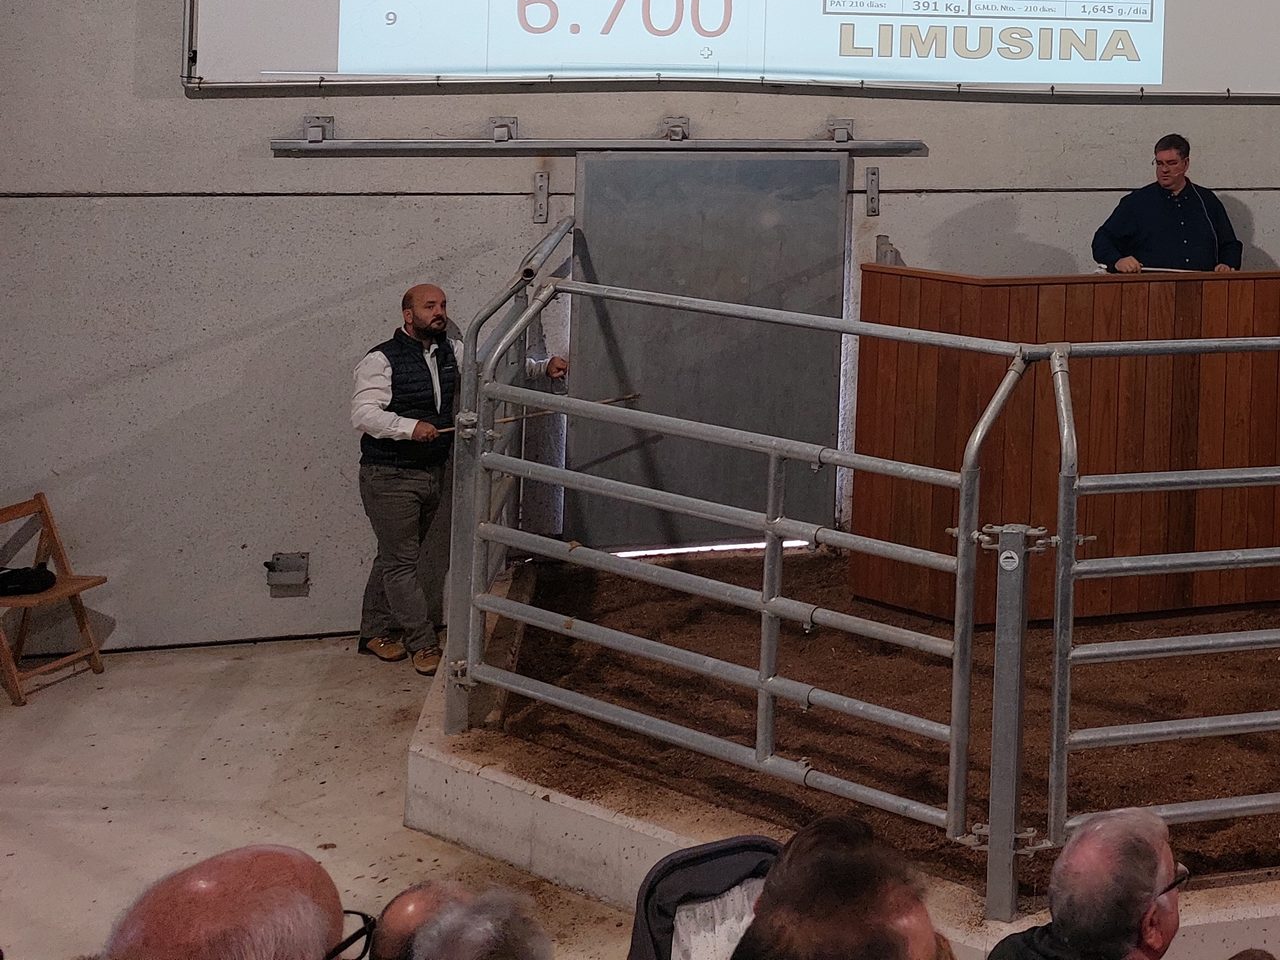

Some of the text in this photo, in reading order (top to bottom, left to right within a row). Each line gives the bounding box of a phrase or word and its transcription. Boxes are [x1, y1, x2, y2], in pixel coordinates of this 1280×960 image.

[912, 1, 965, 13] 391 Kg.
[1081, 4, 1114, 16] 1,645
[384, 12, 398, 26] 9
[838, 22, 1141, 63] LIMUSINA
